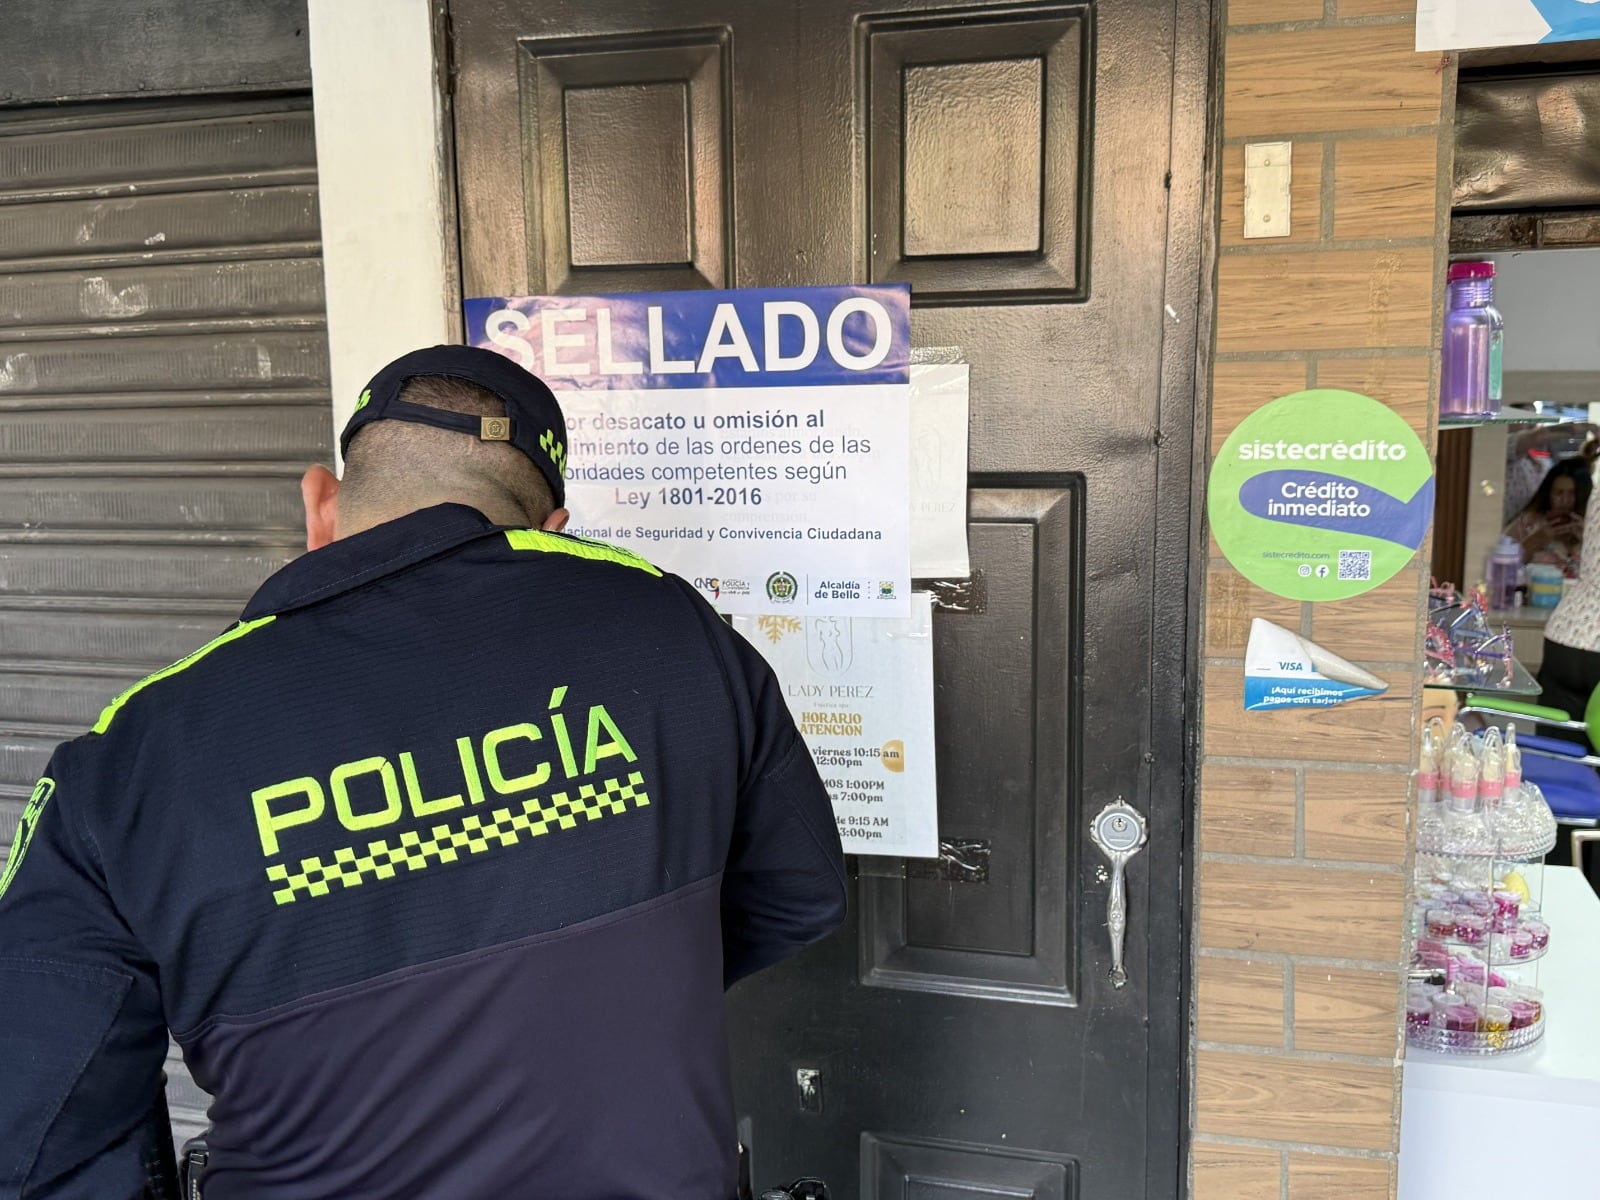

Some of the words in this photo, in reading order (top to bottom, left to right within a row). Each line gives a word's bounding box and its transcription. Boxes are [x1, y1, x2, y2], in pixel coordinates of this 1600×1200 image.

[485, 296, 893, 376] SELLADO
[567, 415, 587, 431] or
[592, 413, 686, 431] desacato
[694, 415, 706, 429] u
[713, 410, 798, 429] omisión
[806, 409, 825, 428] al
[567, 436, 649, 456] limiento
[655, 437, 680, 455] de
[687, 436, 714, 455] las
[720, 436, 802, 455] ordenes
[809, 436, 834, 454] de
[842, 435, 871, 453] las
[1238, 439, 1407, 461] sistecrédito
[565, 462, 645, 481] oridades
[651, 462, 778, 484] competentes
[785, 461, 847, 484] según
[1281, 481, 1359, 499] Crédito
[615, 487, 650, 509] Ley
[658, 487, 762, 506] 1801-2016
[1268, 498, 1371, 517] inmediato
[615, 526, 632, 538] de
[636, 526, 703, 541] Seguridad
[707, 530, 715, 542] y
[719, 526, 803, 540] Convivencia
[807, 527, 882, 541] Ciudadana
[1262, 550, 1330, 560] sistecredito.com
[819, 580, 860, 590] Alcaldía
[814, 590, 827, 600] de
[832, 590, 860, 600] Bello
[1279, 661, 1304, 671] VISA
[788, 684, 824, 697] LADY
[829, 685, 875, 698] PEREZ
[1271, 686, 1296, 696] ¡Aquí
[1298, 687, 1343, 697] recibimos
[1263, 695, 1291, 704] pagos
[1292, 696, 1310, 704] con
[802, 711, 862, 725] HORARIO
[812, 746, 852, 756] viernes
[854, 747, 881, 758] 10:15
[883, 750, 900, 759] am
[816, 756, 863, 768] 12:00pm
[250, 685, 638, 856] POLICÍA
[846, 780, 885, 790] 1:00PM
[841, 792, 884, 804] 7:00pm
[848, 816, 871, 826] 9:15
[873, 816, 889, 827] AM
[840, 827, 883, 840] 3:00pm
